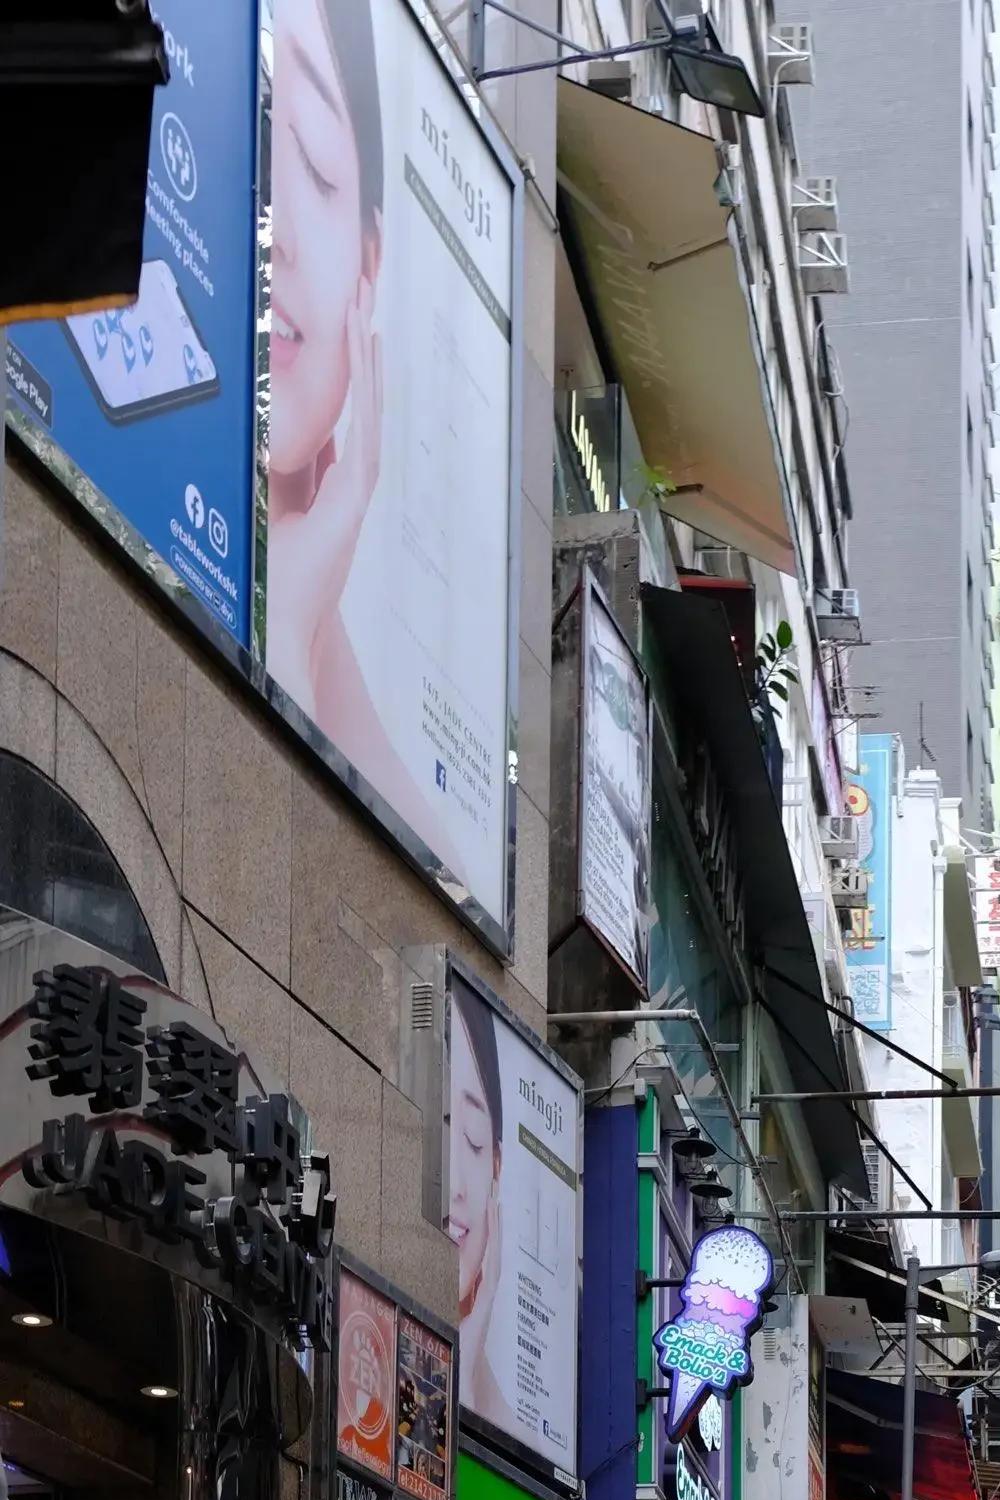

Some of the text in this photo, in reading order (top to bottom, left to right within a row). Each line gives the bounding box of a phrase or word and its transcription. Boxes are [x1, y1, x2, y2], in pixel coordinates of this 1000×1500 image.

[421, 107, 492, 242] mingji
[183, 248, 214, 297] places
[29, 382, 49, 417] Play
[170, 518, 238, 601] @tableworkshk
[519, 1077, 563, 1136] mingji
[22, 1112, 208, 1247] JADE
[403, 1317, 446, 1361] ZEN 6/F
[661, 1324, 746, 1371] Emack &
[665, 1347, 727, 1384] Bolio's
